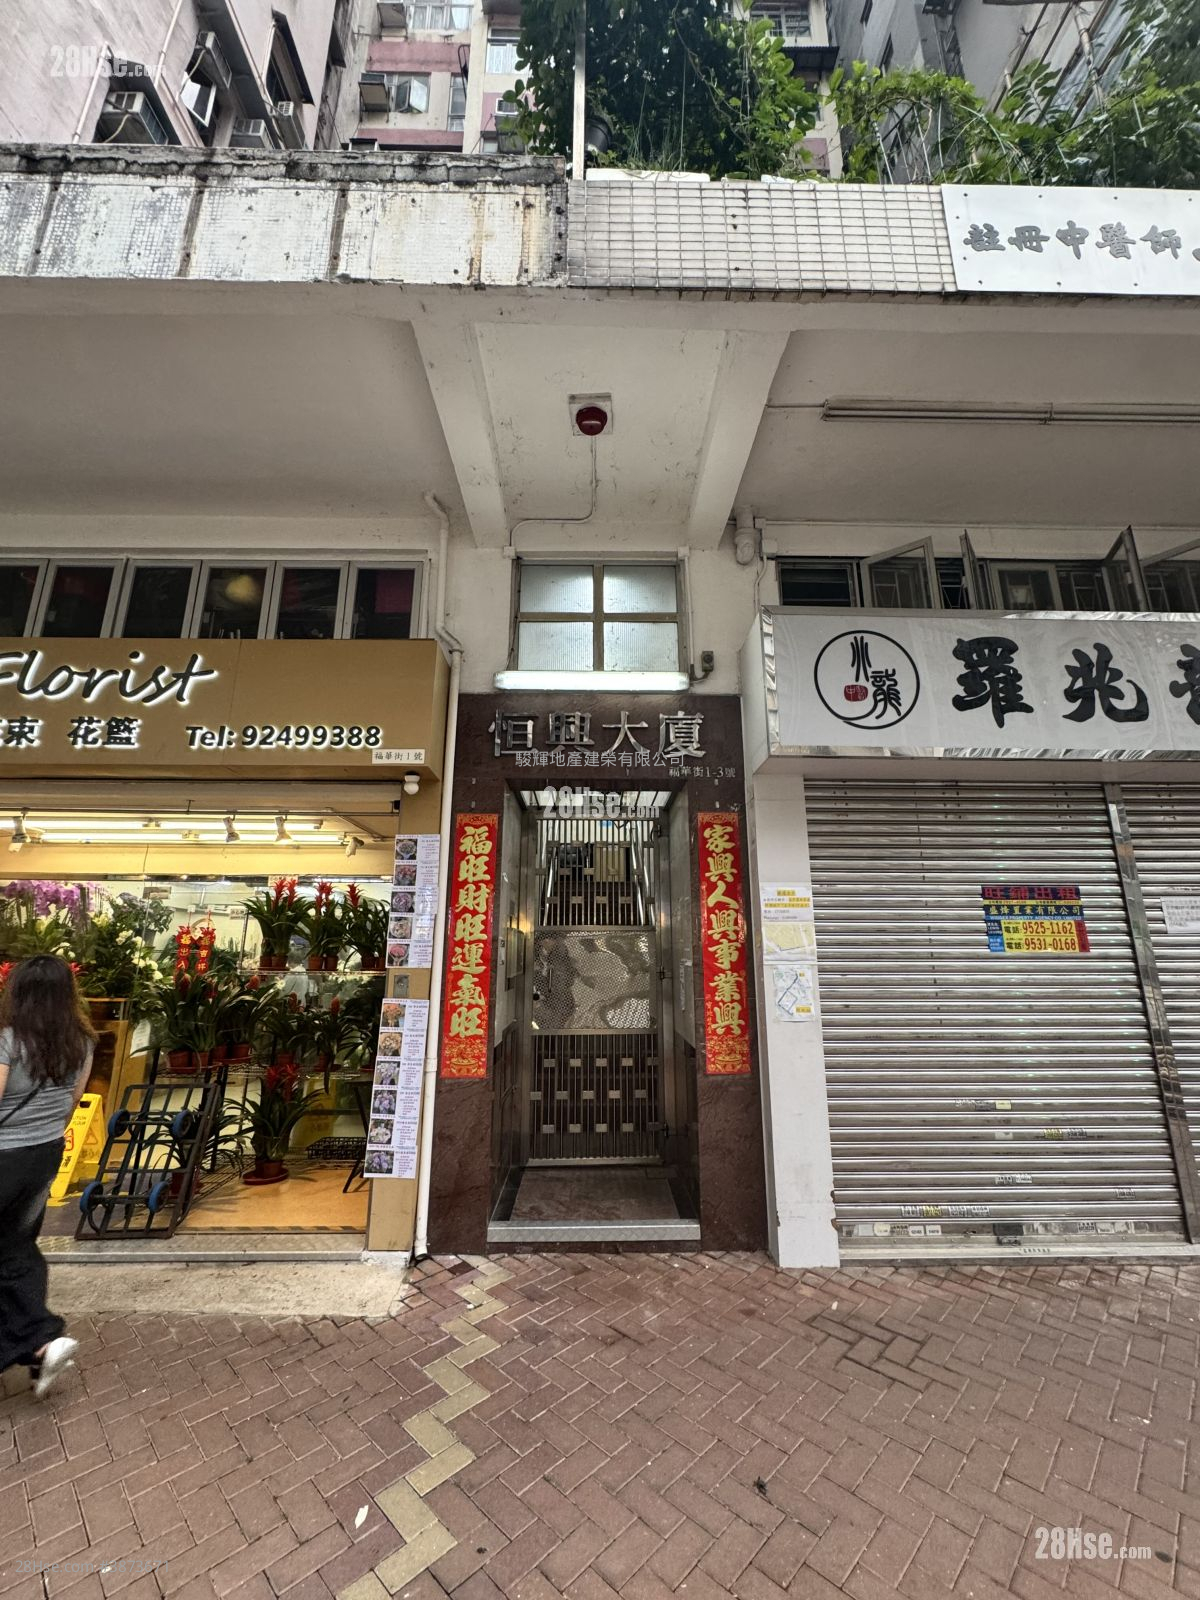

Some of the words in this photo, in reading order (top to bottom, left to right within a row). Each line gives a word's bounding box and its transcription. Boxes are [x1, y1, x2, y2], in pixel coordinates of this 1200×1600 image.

[963, 219, 1200, 261] 註冊中醫師
[67, 716, 139, 747] 花籃
[185, 725, 235, 747] Tel:
[242, 725, 382, 747] 92499388
[449, 825, 493, 1038] 福旺財旺運氣旺
[703, 824, 746, 1036] 家興人興事業興
[1022, 921, 1074, 935] 9525-1162
[1024, 938, 1077, 951] 9531-0168
